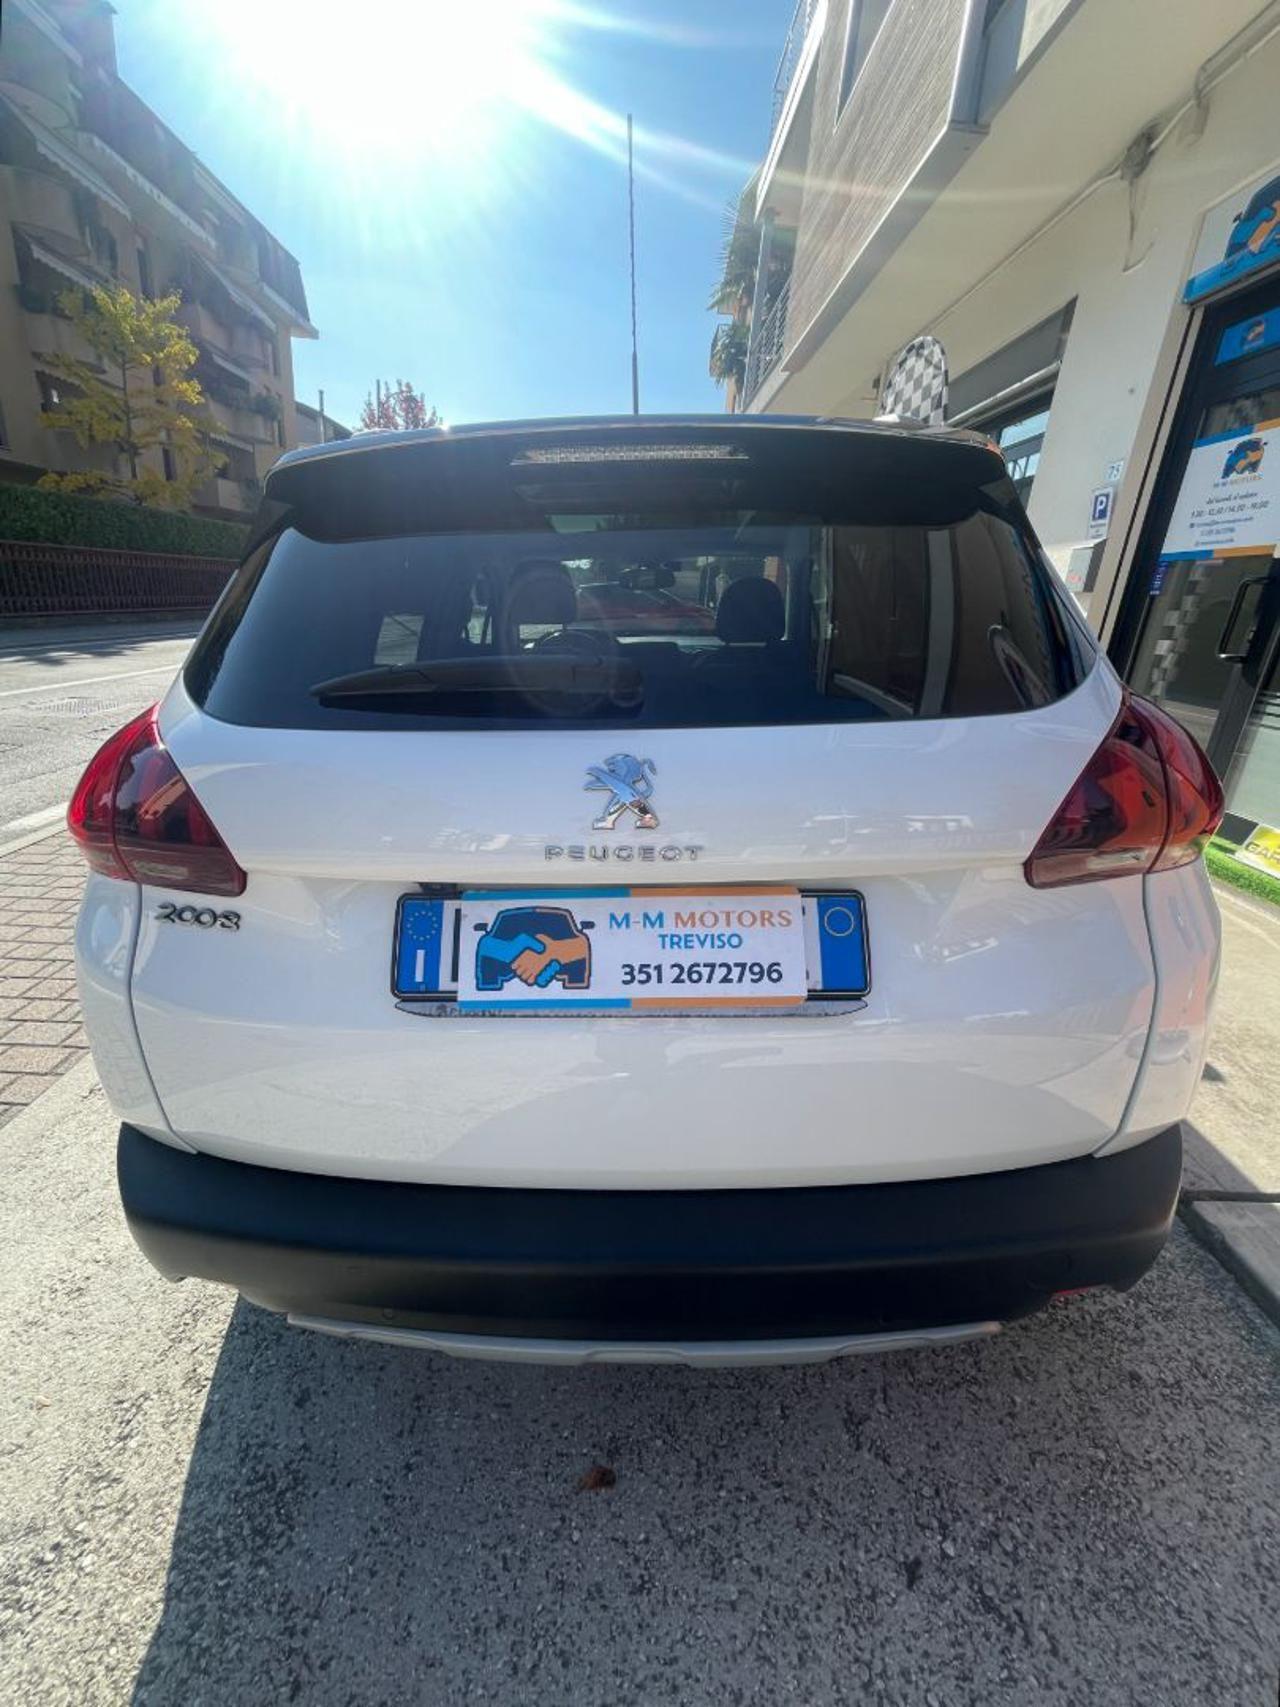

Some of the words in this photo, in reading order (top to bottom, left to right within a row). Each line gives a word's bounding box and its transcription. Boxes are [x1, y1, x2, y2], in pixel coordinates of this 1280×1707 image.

[1095, 494, 1107, 519] P
[544, 845, 704, 862] PEUGEOT
[155, 902, 241, 930] 2008
[609, 911, 664, 929] M-M
[674, 909, 792, 928] MOTORS
[658, 933, 743, 949] TREVISO
[621, 963, 663, 985] 351
[670, 961, 783, 984] 2672796
